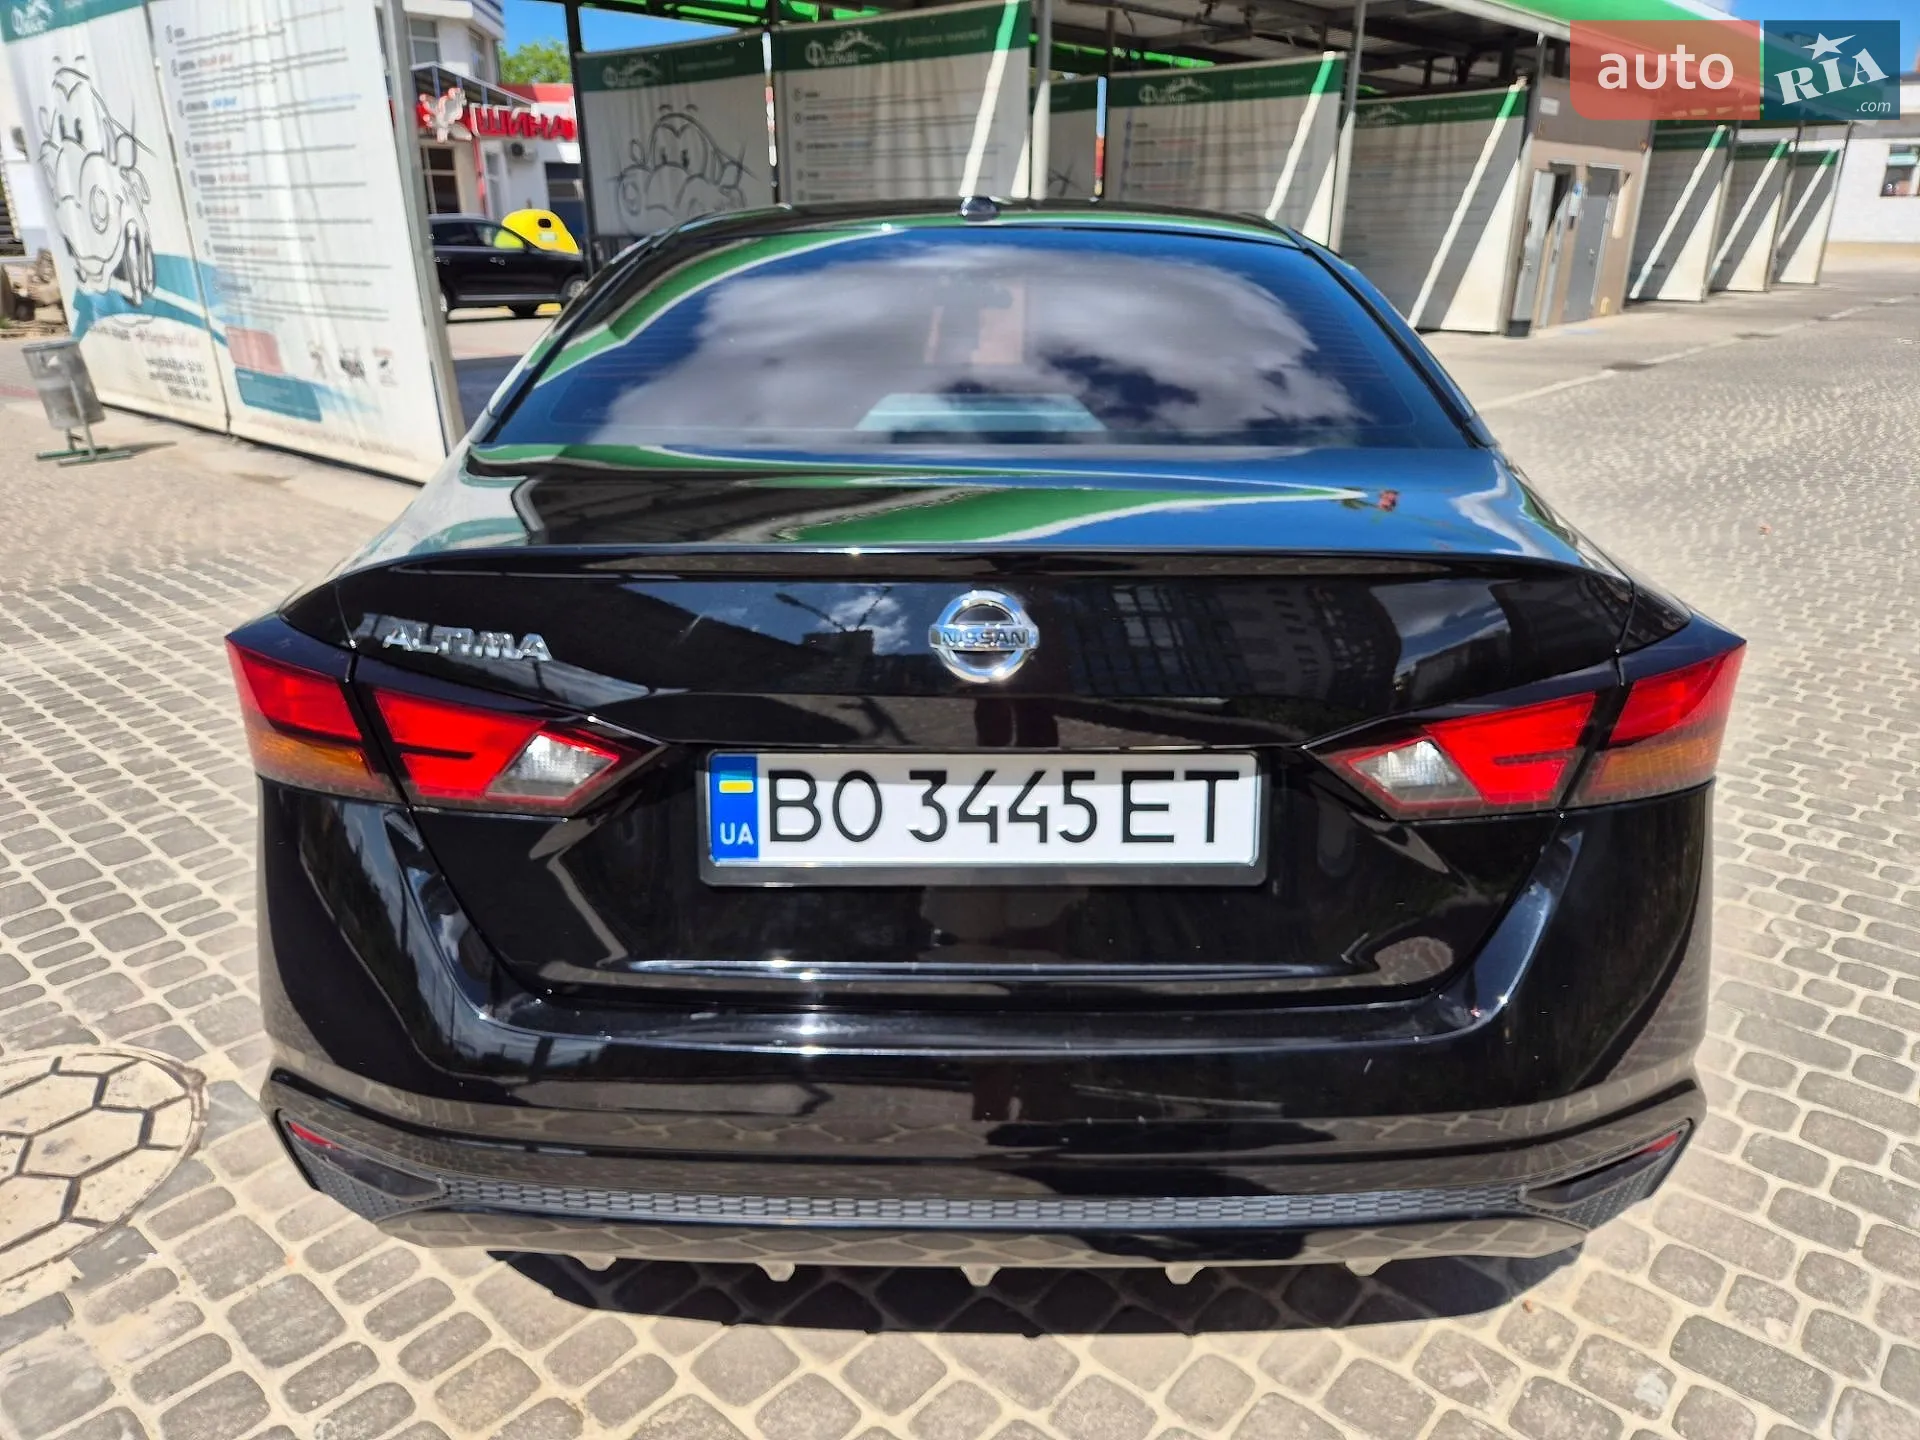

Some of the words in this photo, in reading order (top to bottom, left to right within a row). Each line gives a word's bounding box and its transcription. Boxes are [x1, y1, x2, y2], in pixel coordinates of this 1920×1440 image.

[942, 630, 1027, 648] NISSAN
[767, 769, 883, 843] BO
[907, 769, 1098, 843] 3445
[1120, 770, 1240, 843] ET
[720, 822, 755, 846] UA
